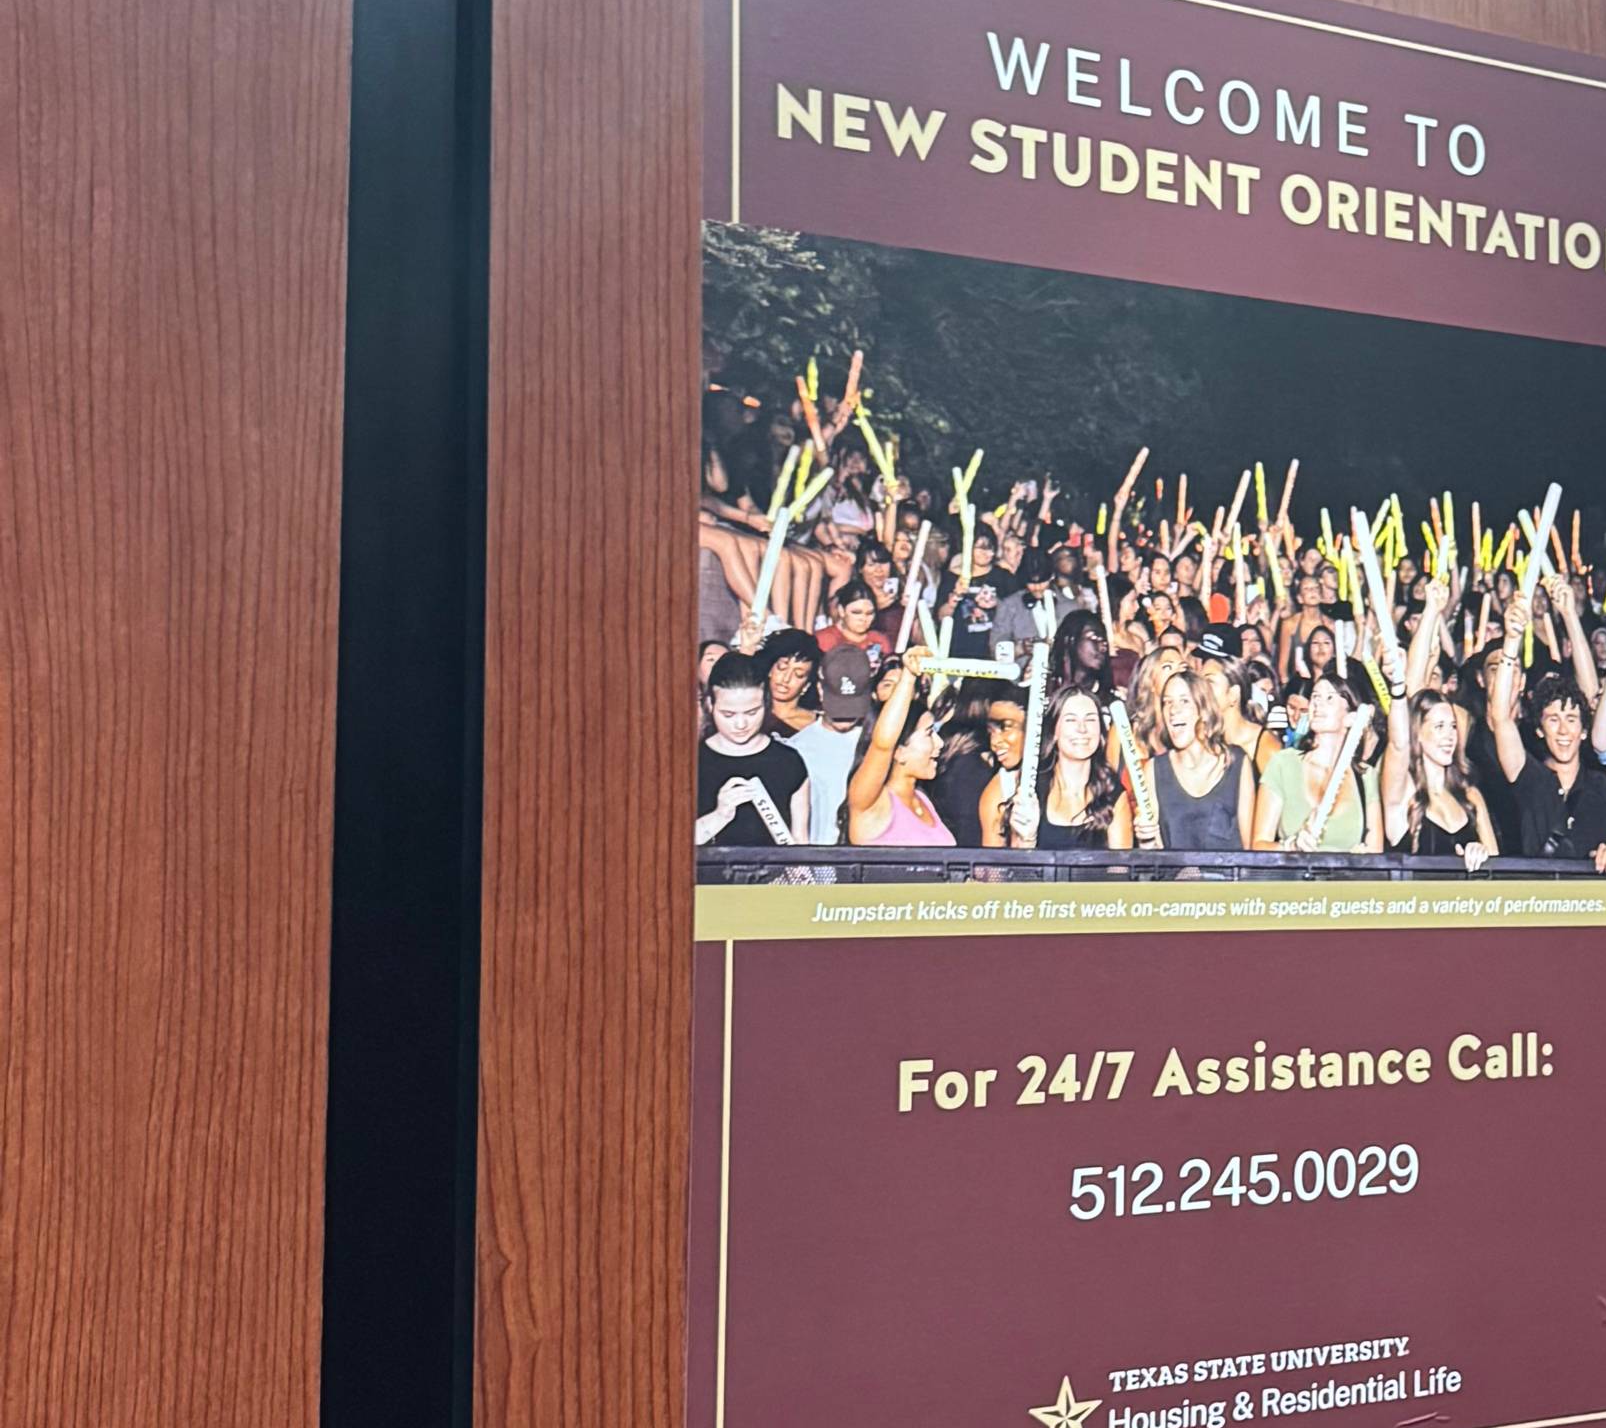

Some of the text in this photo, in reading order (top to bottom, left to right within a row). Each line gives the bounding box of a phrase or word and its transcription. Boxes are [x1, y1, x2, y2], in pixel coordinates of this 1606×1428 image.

[986, 31, 1486, 177] WELCOME TO
[776, 83, 947, 162] NEW
[970, 118, 1261, 215] STUDENT
[811, 896, 1606, 925] Jumpstart kicks off the first week on-campus with special guests and a variety of performances.
[899, 1032, 1555, 1112] For 24/7 Assistance Call:
[1069, 1143, 1420, 1220] 512.245.0029
[1108, 1362, 1189, 1393] TEXAS
[1193, 1353, 1266, 1382] STATE
[1232, 1391, 1254, 1421] &
[1262, 1370, 1408, 1418] Residential
[1414, 1365, 1462, 1398] Life
